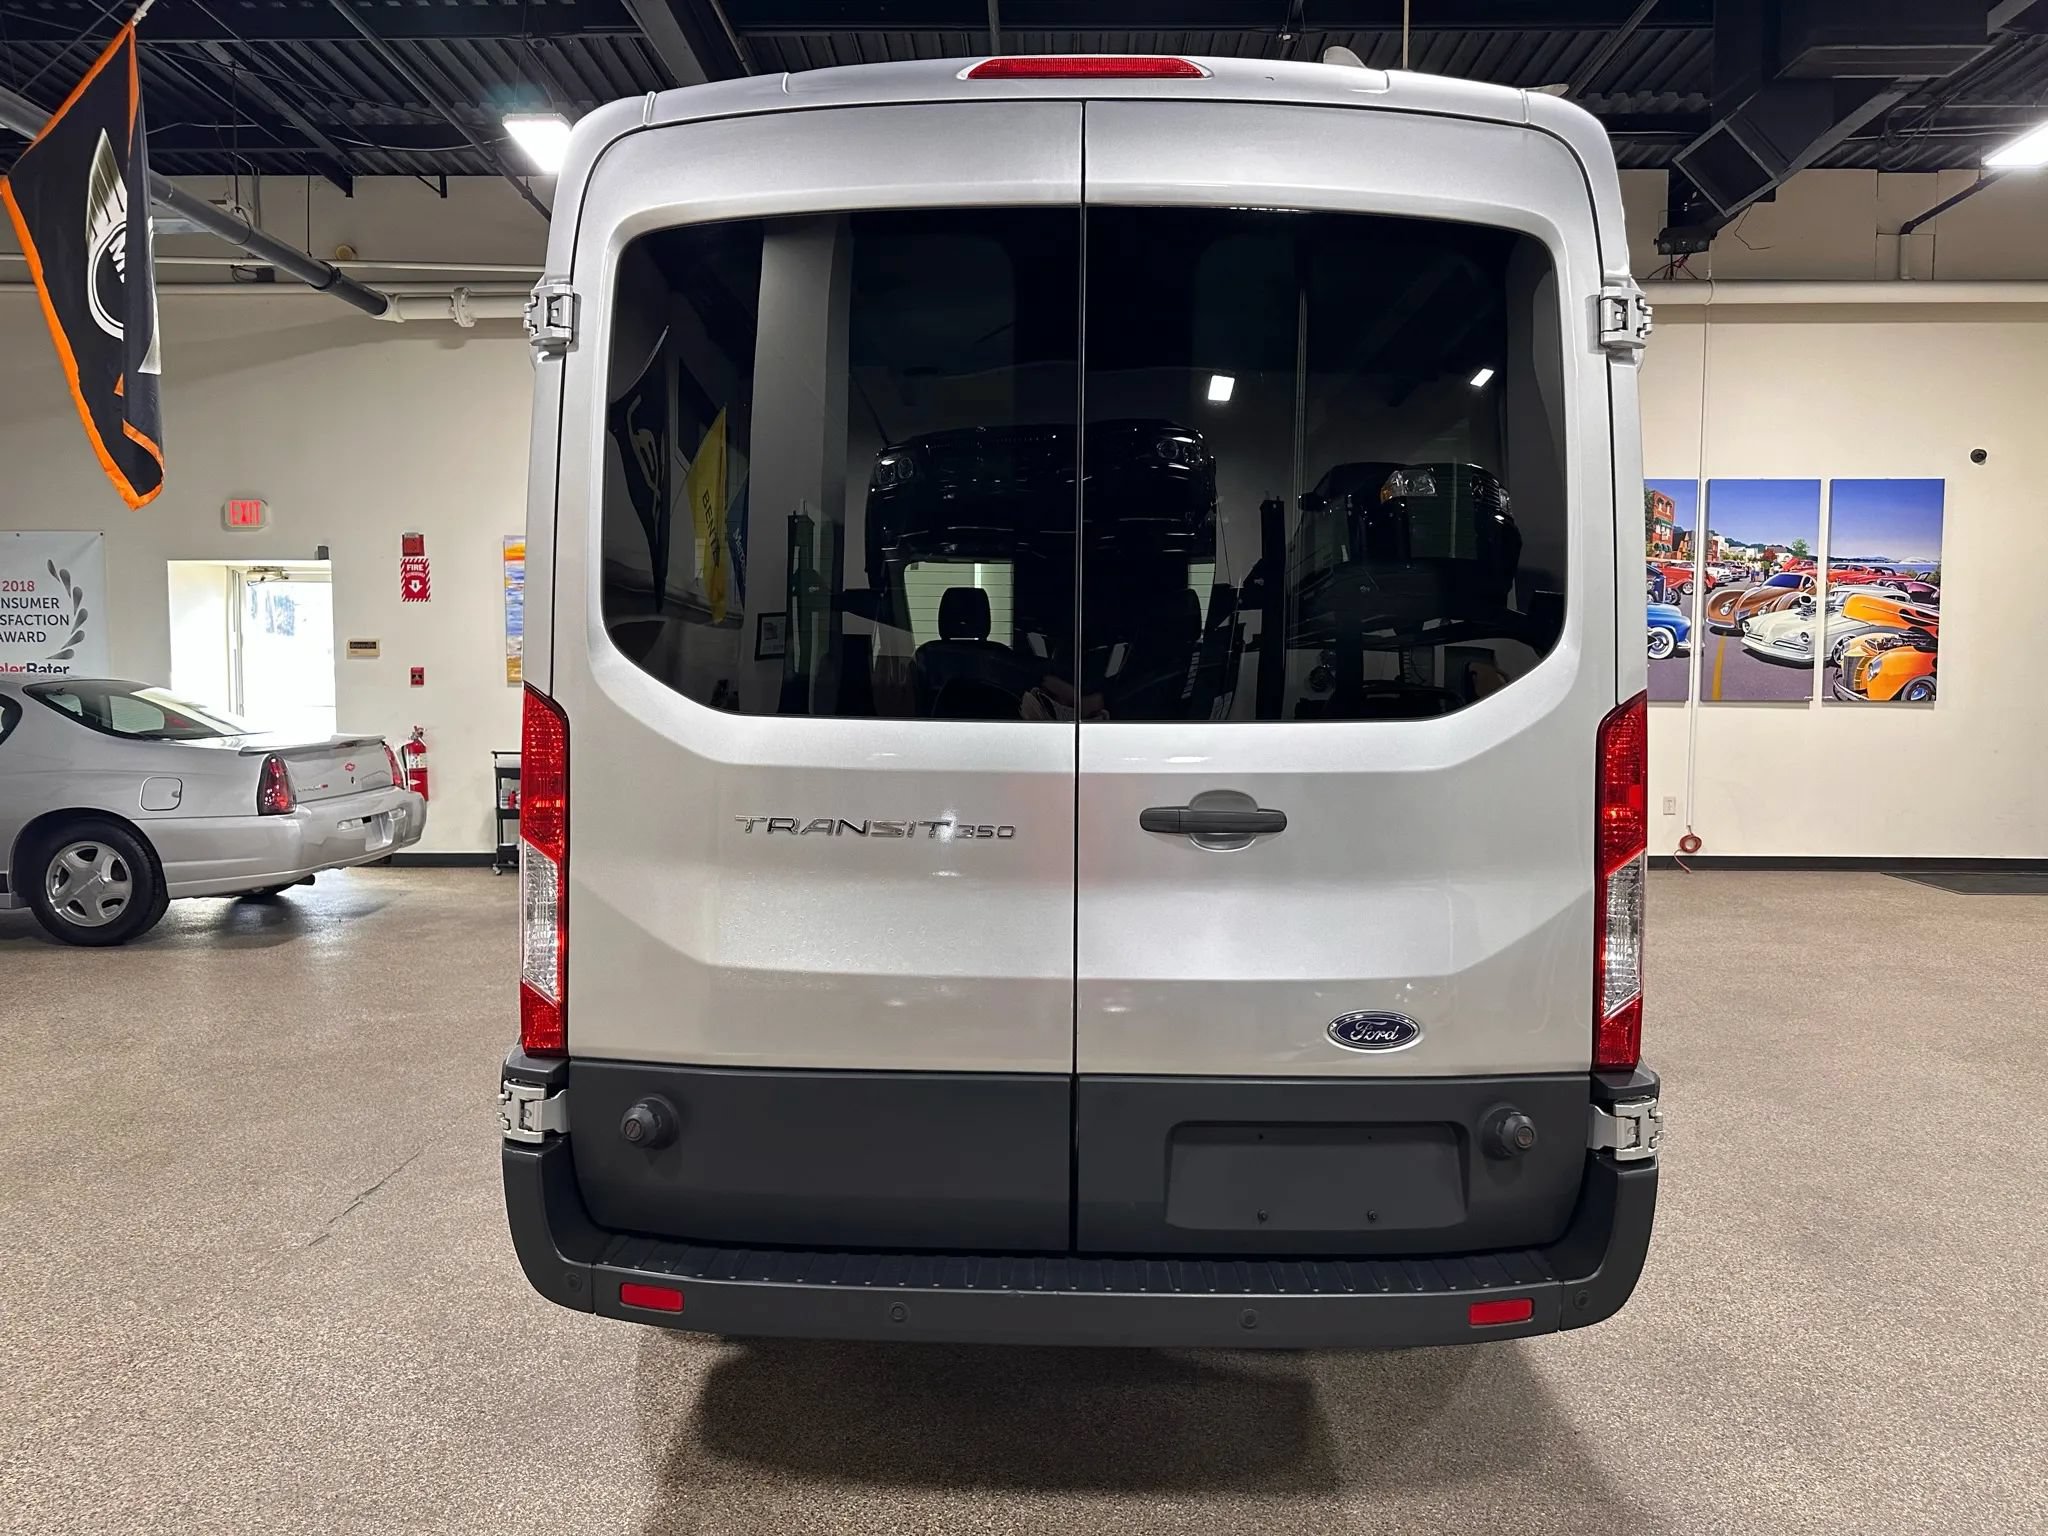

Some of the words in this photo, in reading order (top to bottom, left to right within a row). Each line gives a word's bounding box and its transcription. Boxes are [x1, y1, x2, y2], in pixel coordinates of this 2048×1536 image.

[231, 501, 261, 525] EXIT
[406, 563, 424, 571] FIRE
[2, 580, 35, 592] 2018
[0, 614, 70, 626] SFACTION
[735, 815, 951, 838] TRANSIT
[955, 824, 1016, 839] 350
[1350, 1020, 1400, 1041] Ford
